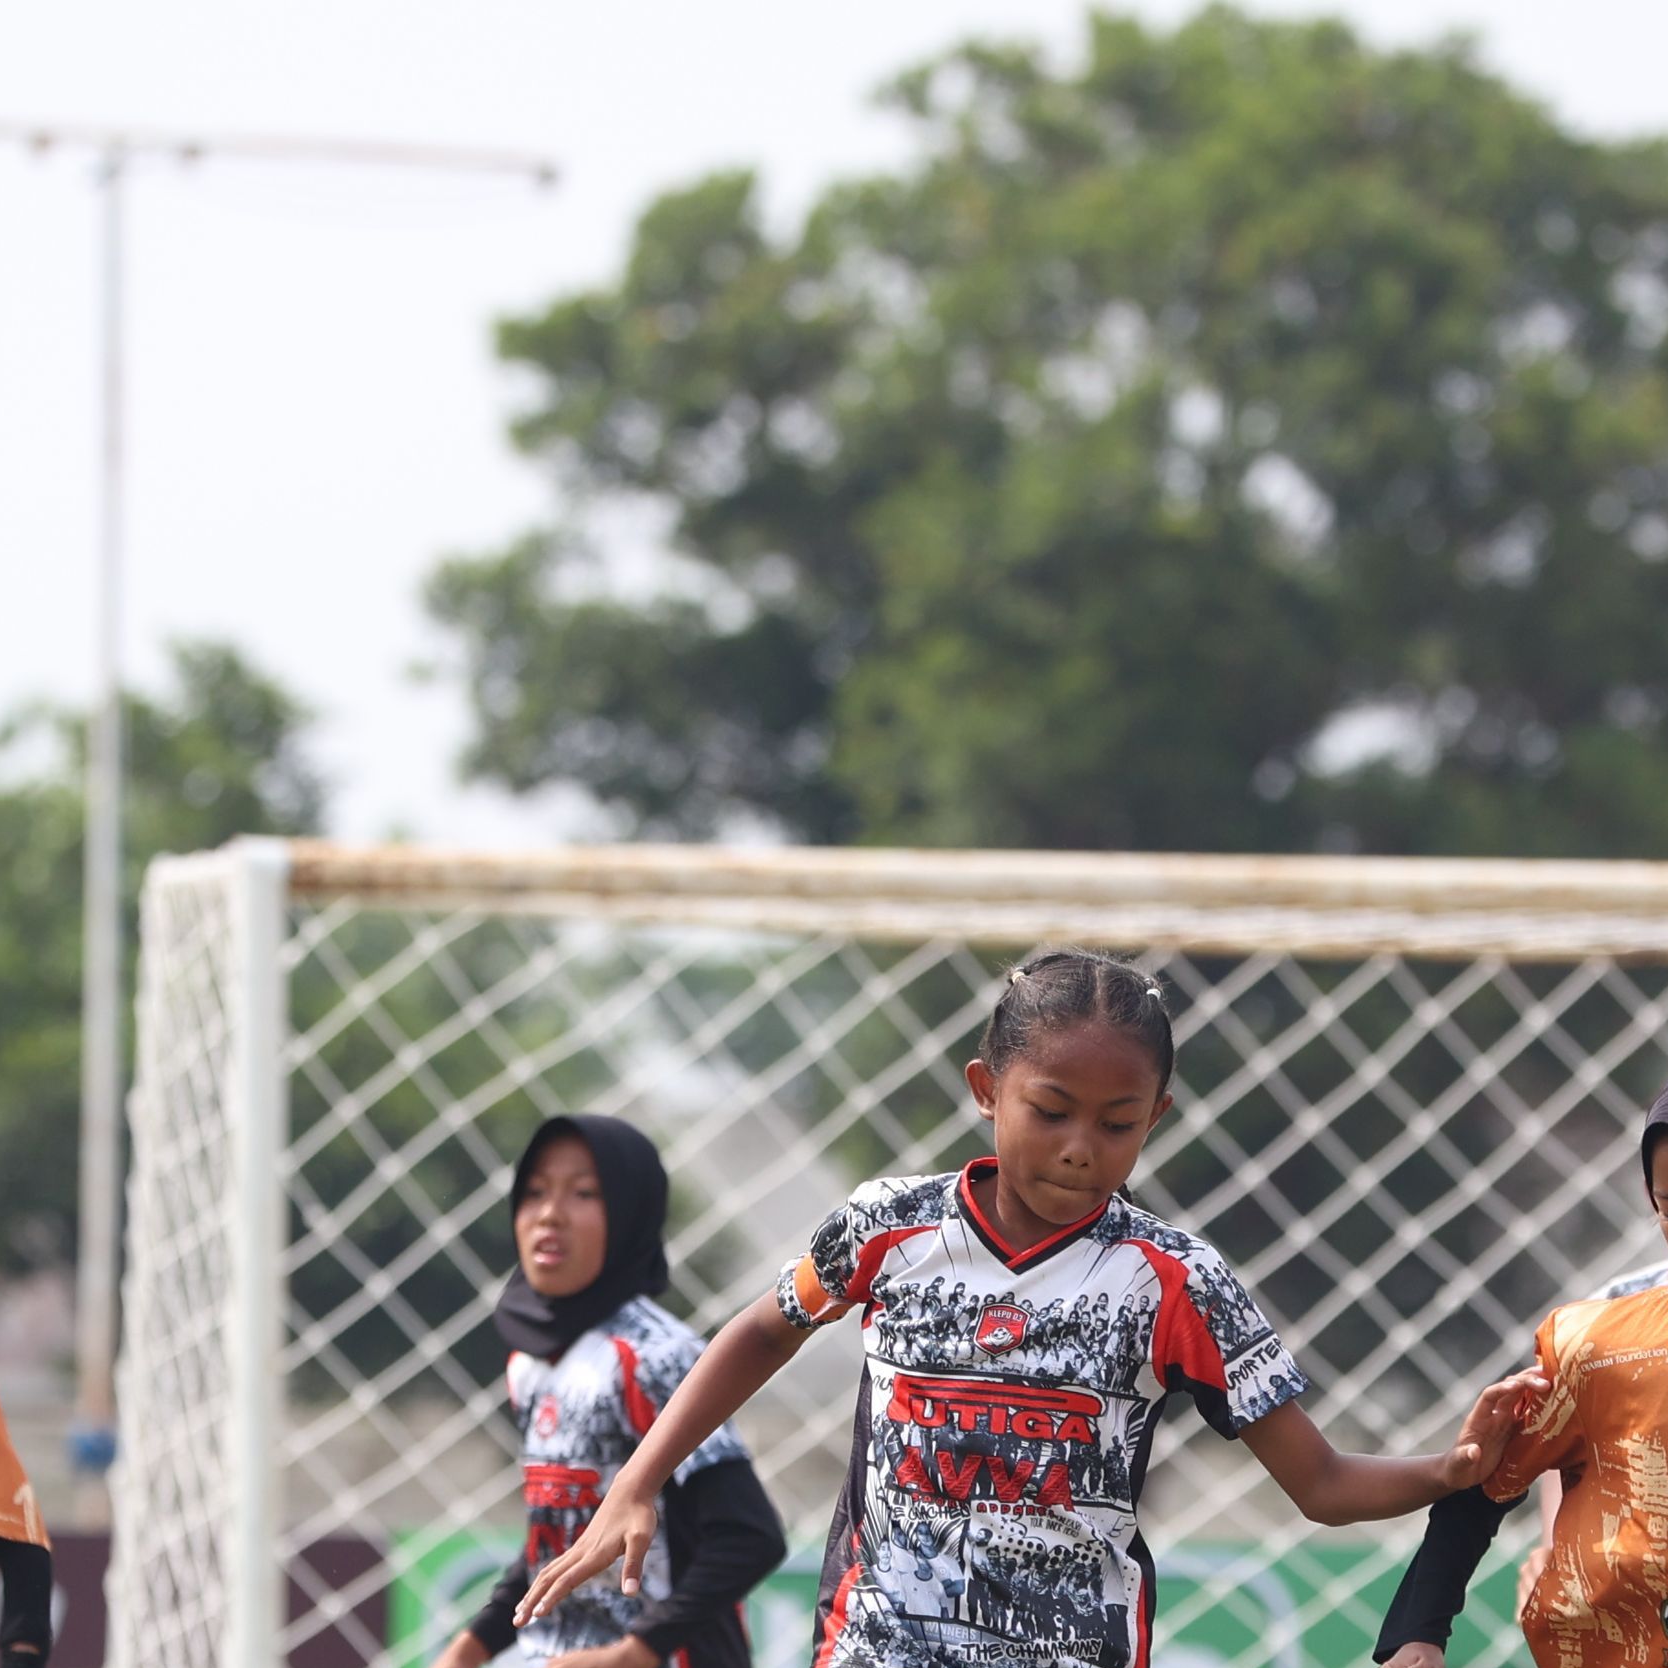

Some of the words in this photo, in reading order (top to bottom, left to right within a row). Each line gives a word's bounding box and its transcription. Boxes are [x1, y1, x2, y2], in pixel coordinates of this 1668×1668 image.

[1224, 1337, 1284, 1391] UPORTER
[1616, 1346, 1668, 1365] foundation
[924, 1621, 977, 1641] WINNERS
[961, 1642, 1004, 1663] THE
[1004, 1638, 1103, 1661] CHAMPIONS
